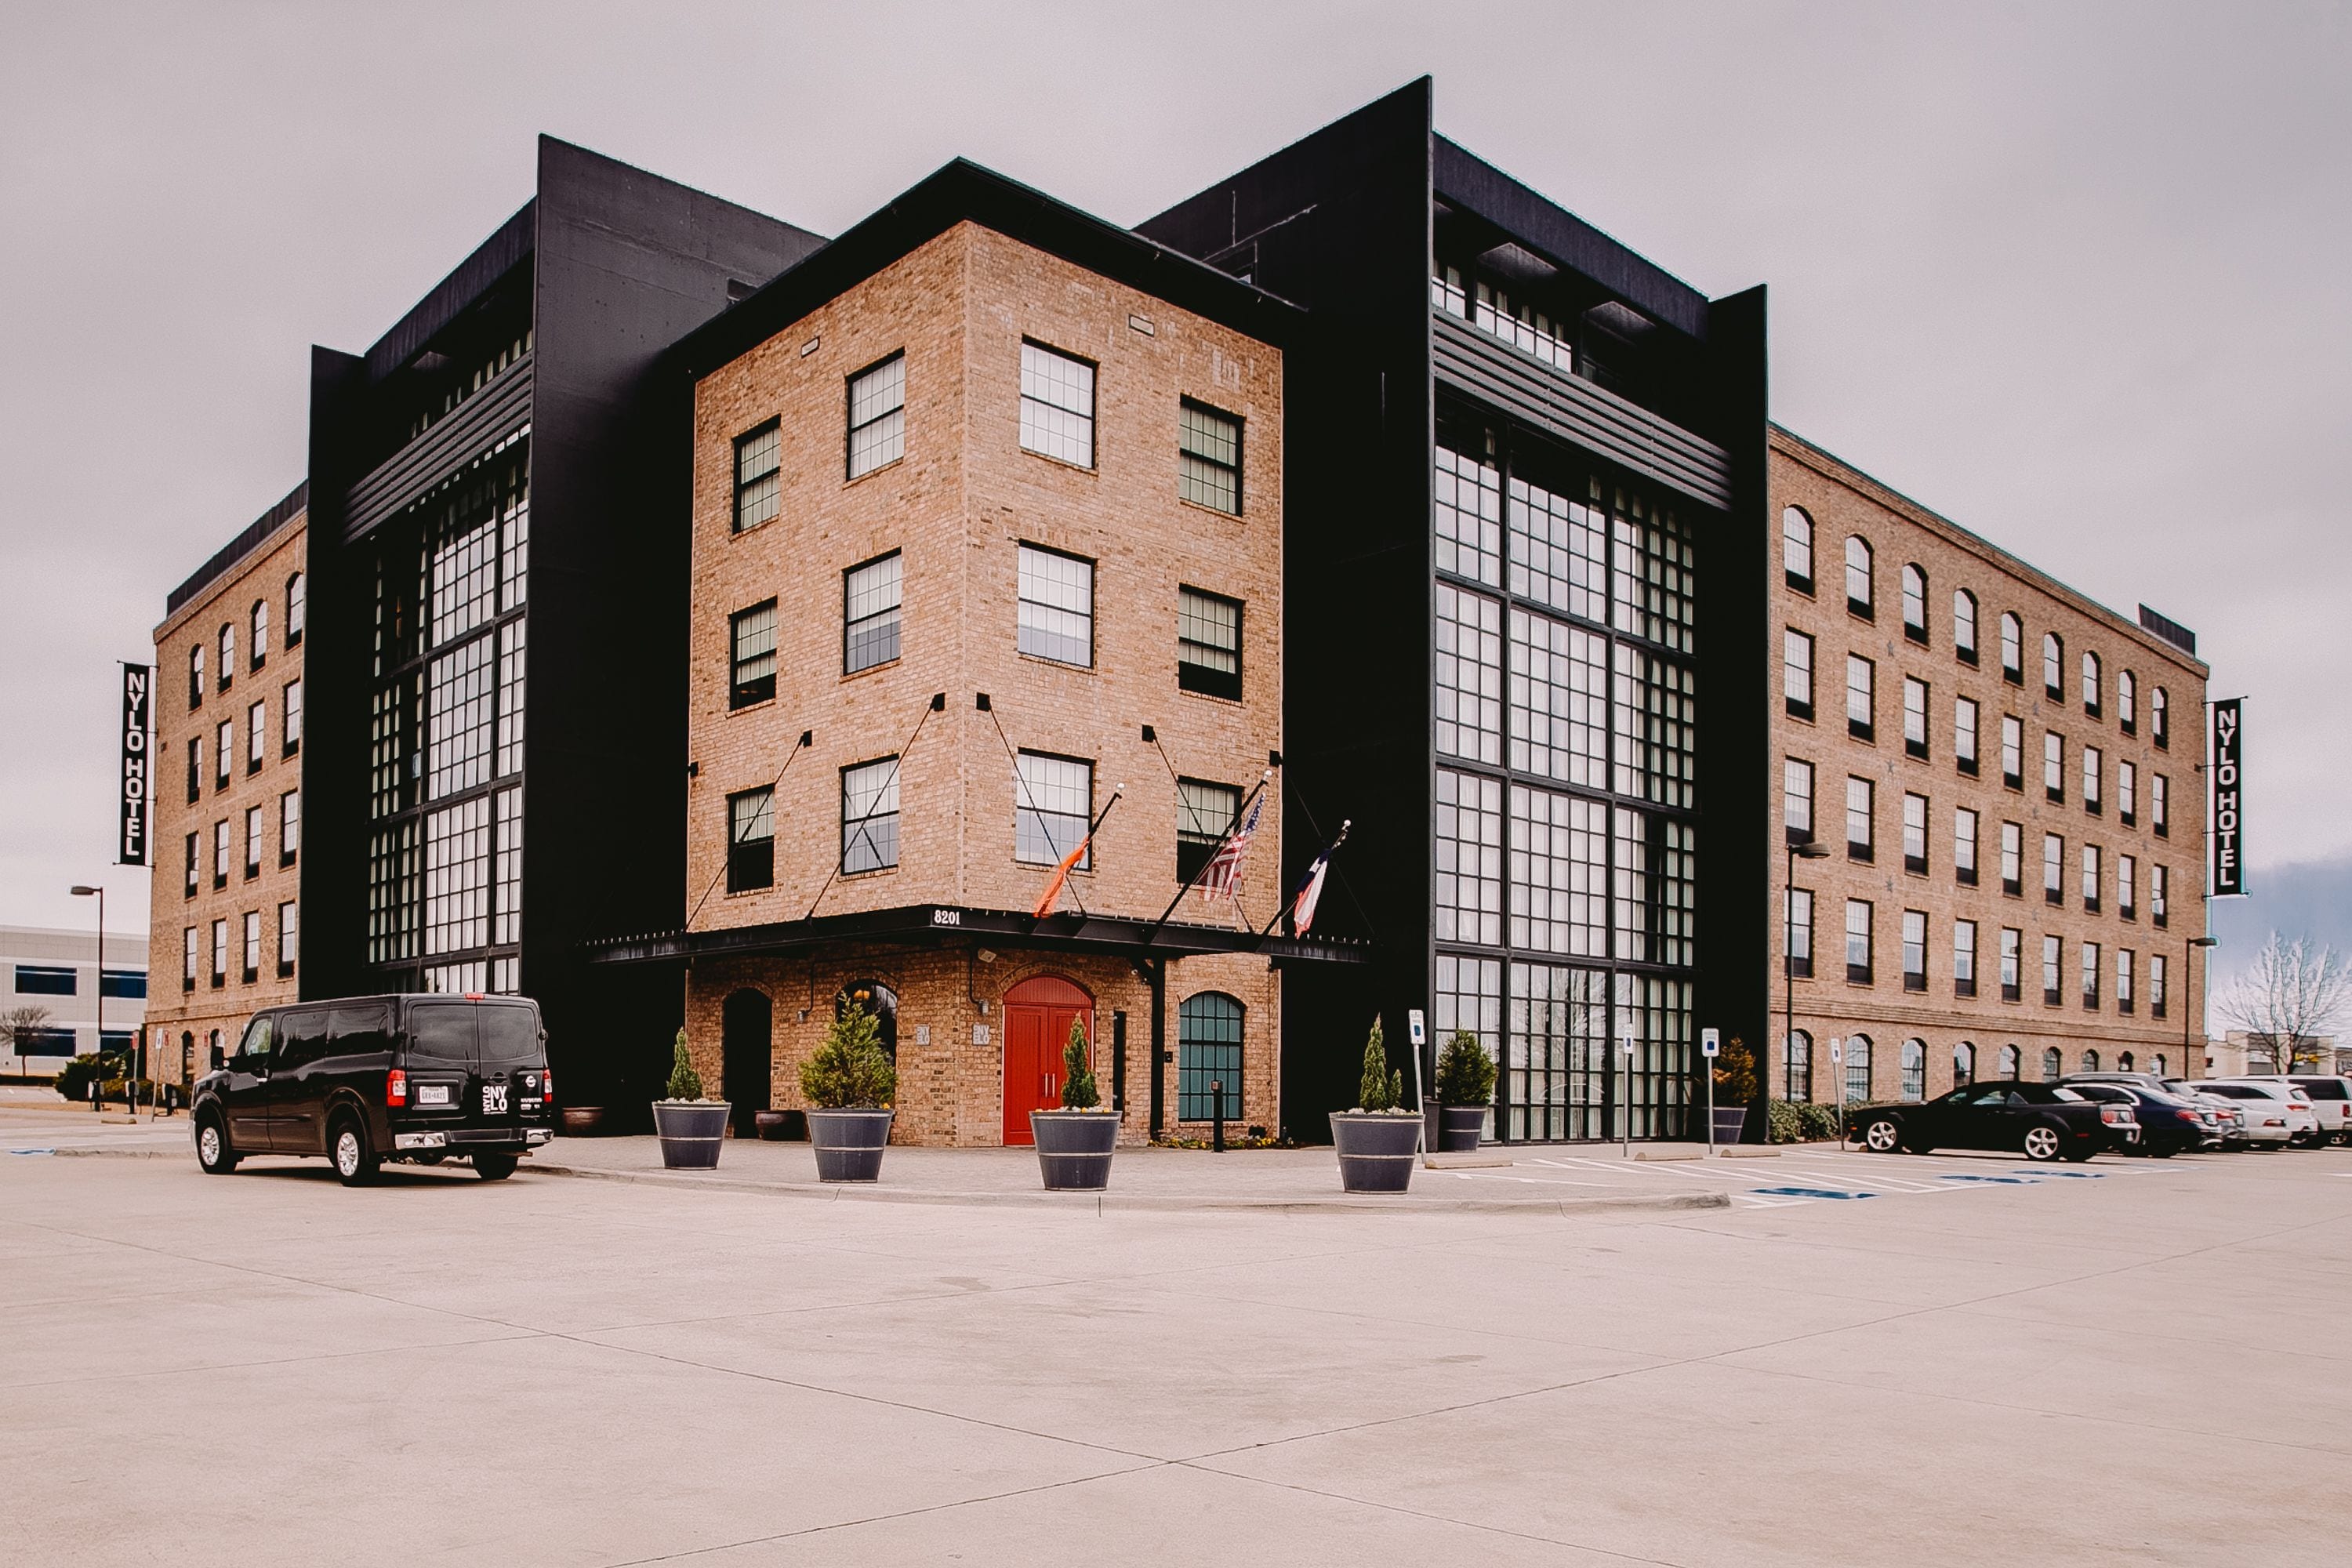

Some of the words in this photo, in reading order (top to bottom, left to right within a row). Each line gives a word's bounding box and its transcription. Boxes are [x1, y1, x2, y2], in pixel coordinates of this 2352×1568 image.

[127, 672, 145, 752] NYLO
[2218, 709, 2237, 786] NYLO
[125, 757, 143, 856] HOTEL
[2218, 791, 2237, 887] HOTEL
[934, 909, 960, 925] 8201
[482, 1086, 491, 1112] NYLO
[490, 1086, 507, 1099] NY
[490, 1098, 507, 1111] LO
